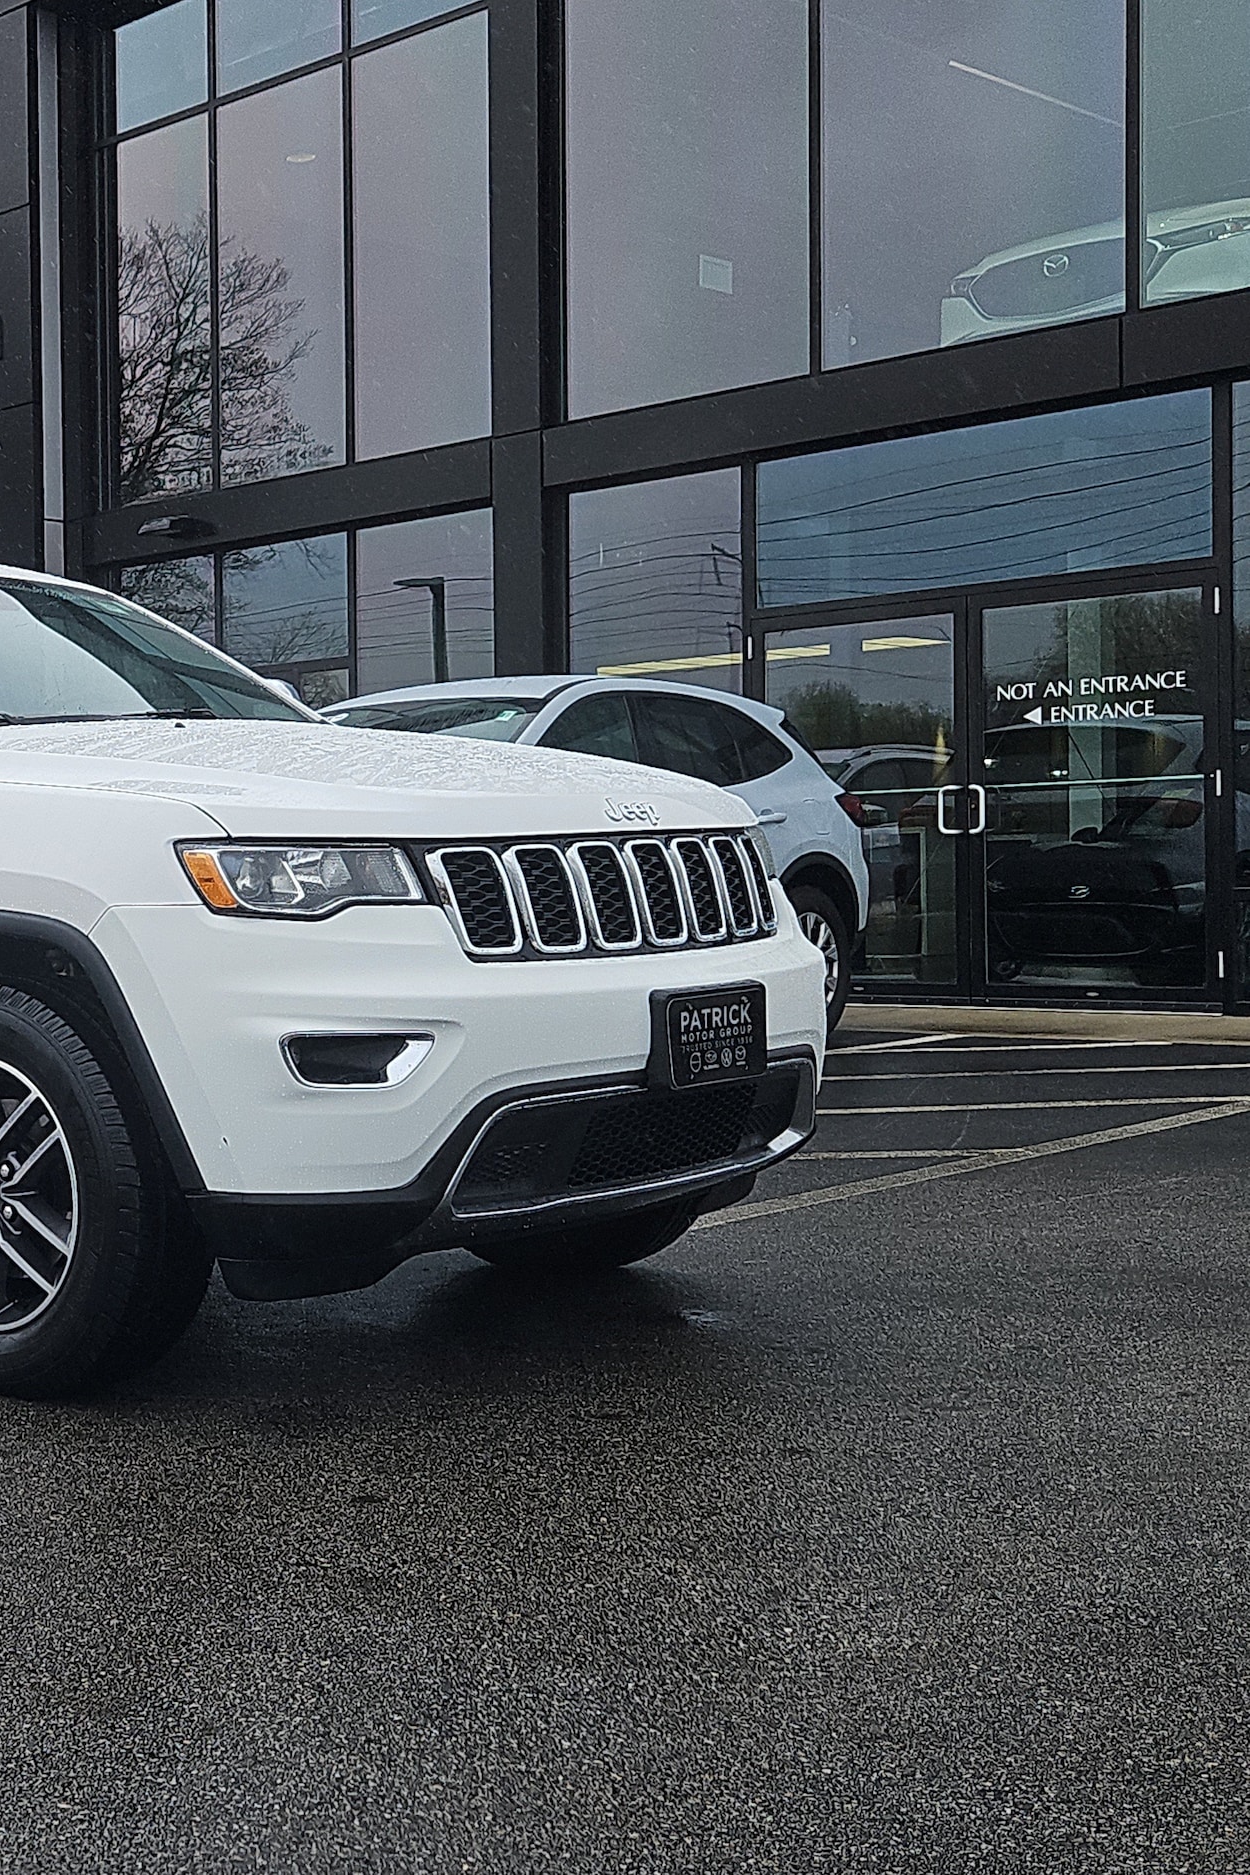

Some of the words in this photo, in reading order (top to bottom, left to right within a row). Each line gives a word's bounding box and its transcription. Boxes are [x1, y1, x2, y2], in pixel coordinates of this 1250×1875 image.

[996, 683, 1037, 701] NOT
[1043, 679, 1073, 698] AN
[1080, 670, 1187, 695] ENTRANCE
[1050, 700, 1155, 723] ENTRANCE
[604, 797, 661, 826] Jeep
[680, 1002, 752, 1032] PATRICK
[681, 1030, 715, 1044] MOTOR
[719, 1025, 753, 1038] GROUP
[715, 1038, 735, 1048] SINCE
